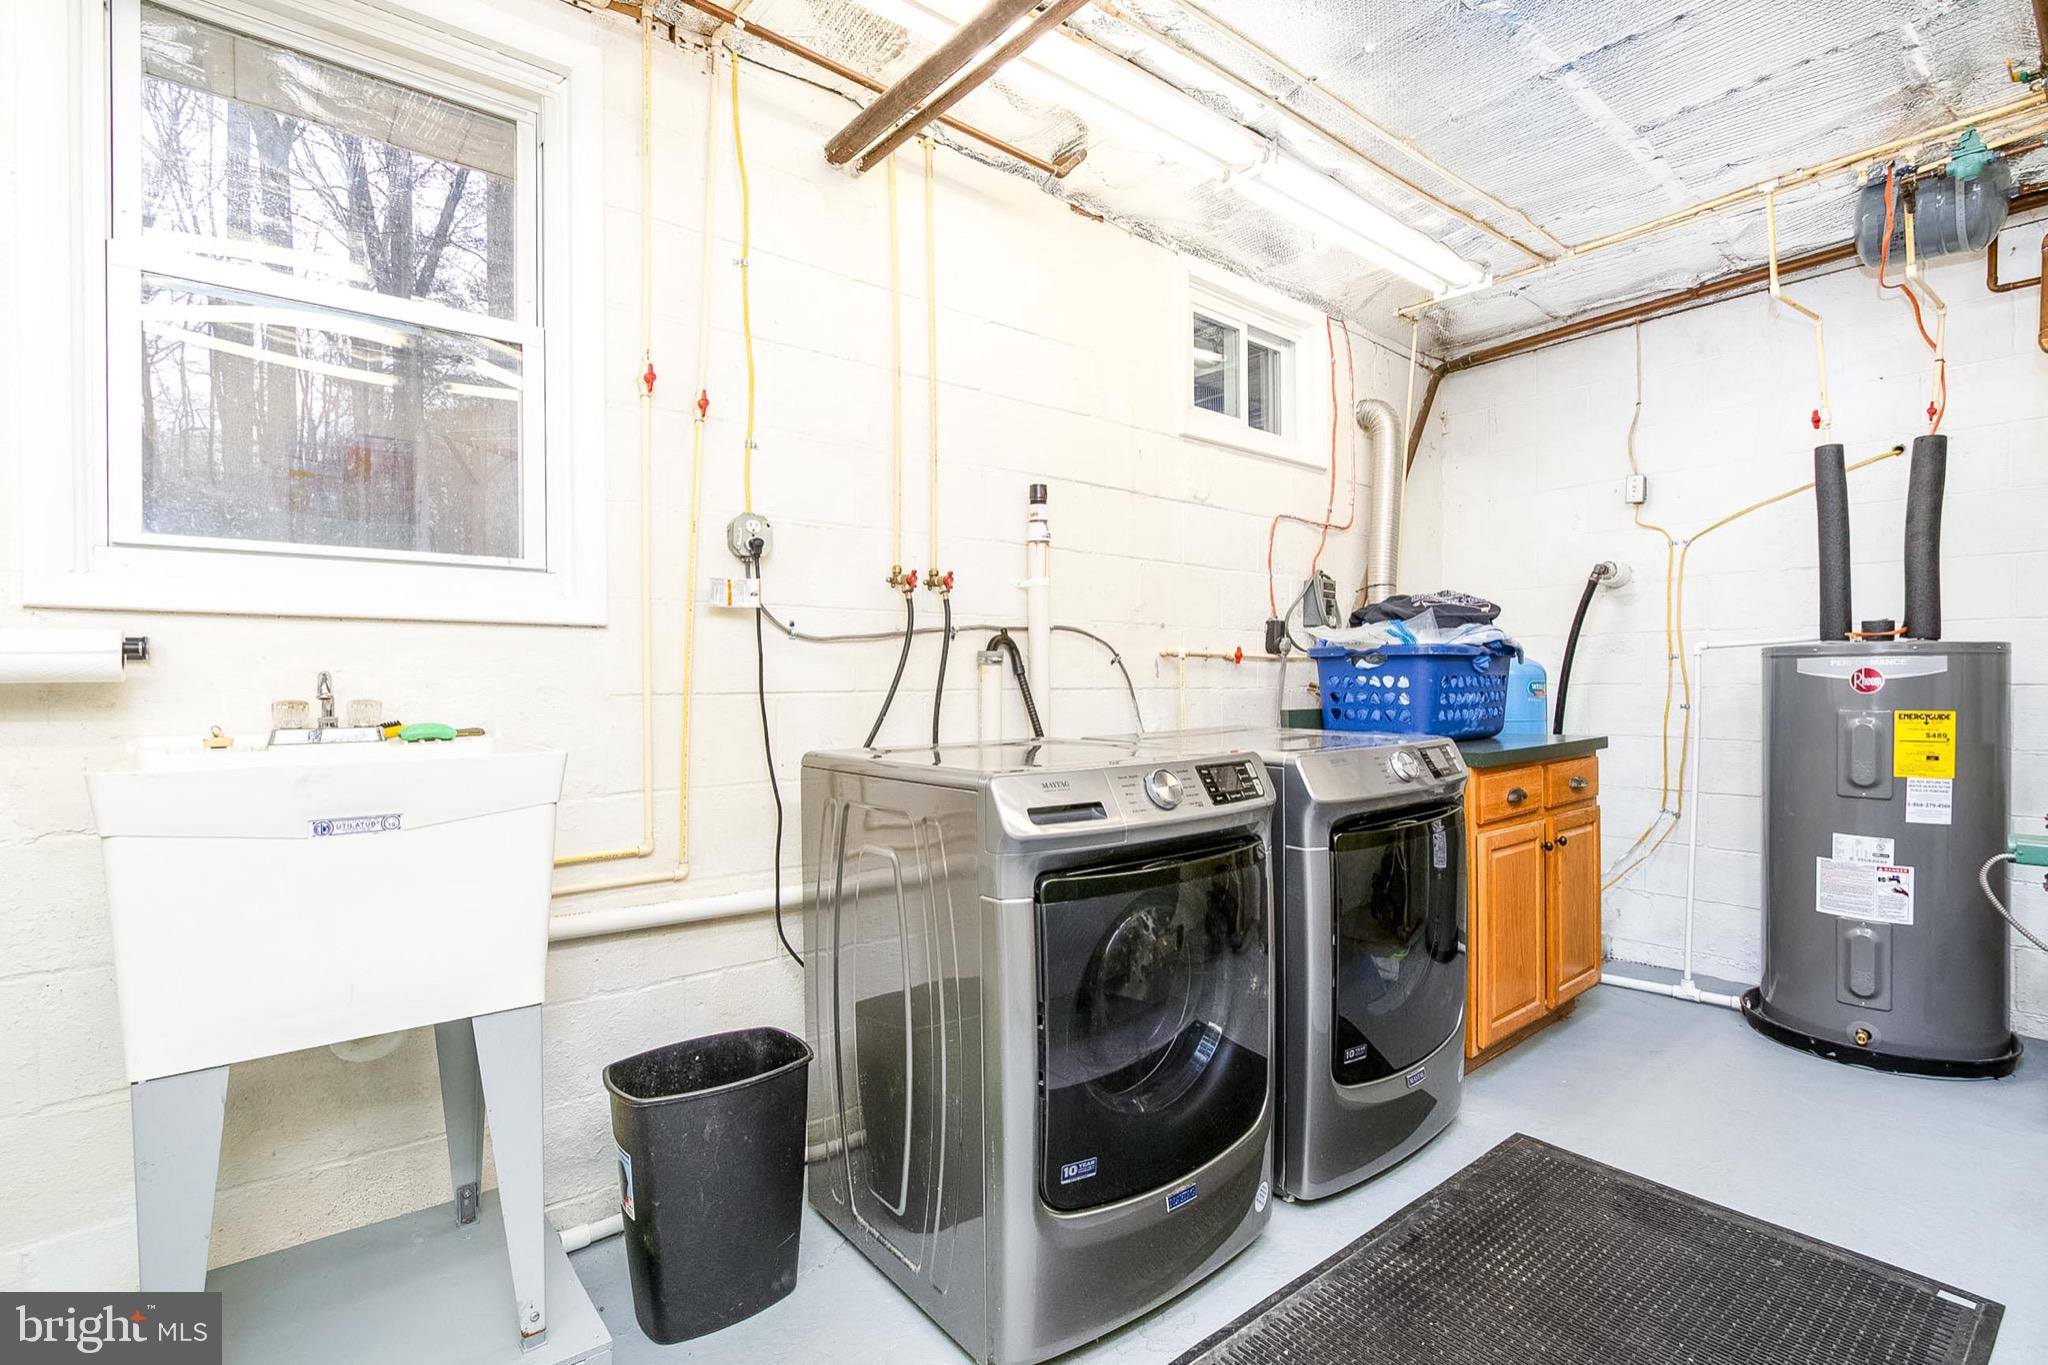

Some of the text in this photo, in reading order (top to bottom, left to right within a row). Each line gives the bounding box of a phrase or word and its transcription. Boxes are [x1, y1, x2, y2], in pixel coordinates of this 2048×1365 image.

[1853, 668, 1882, 689] Rheem
[1041, 781, 1070, 789] MAYTAG
[1063, 1165, 1078, 1178] 10
[1078, 1160, 1095, 1168] YEAR
